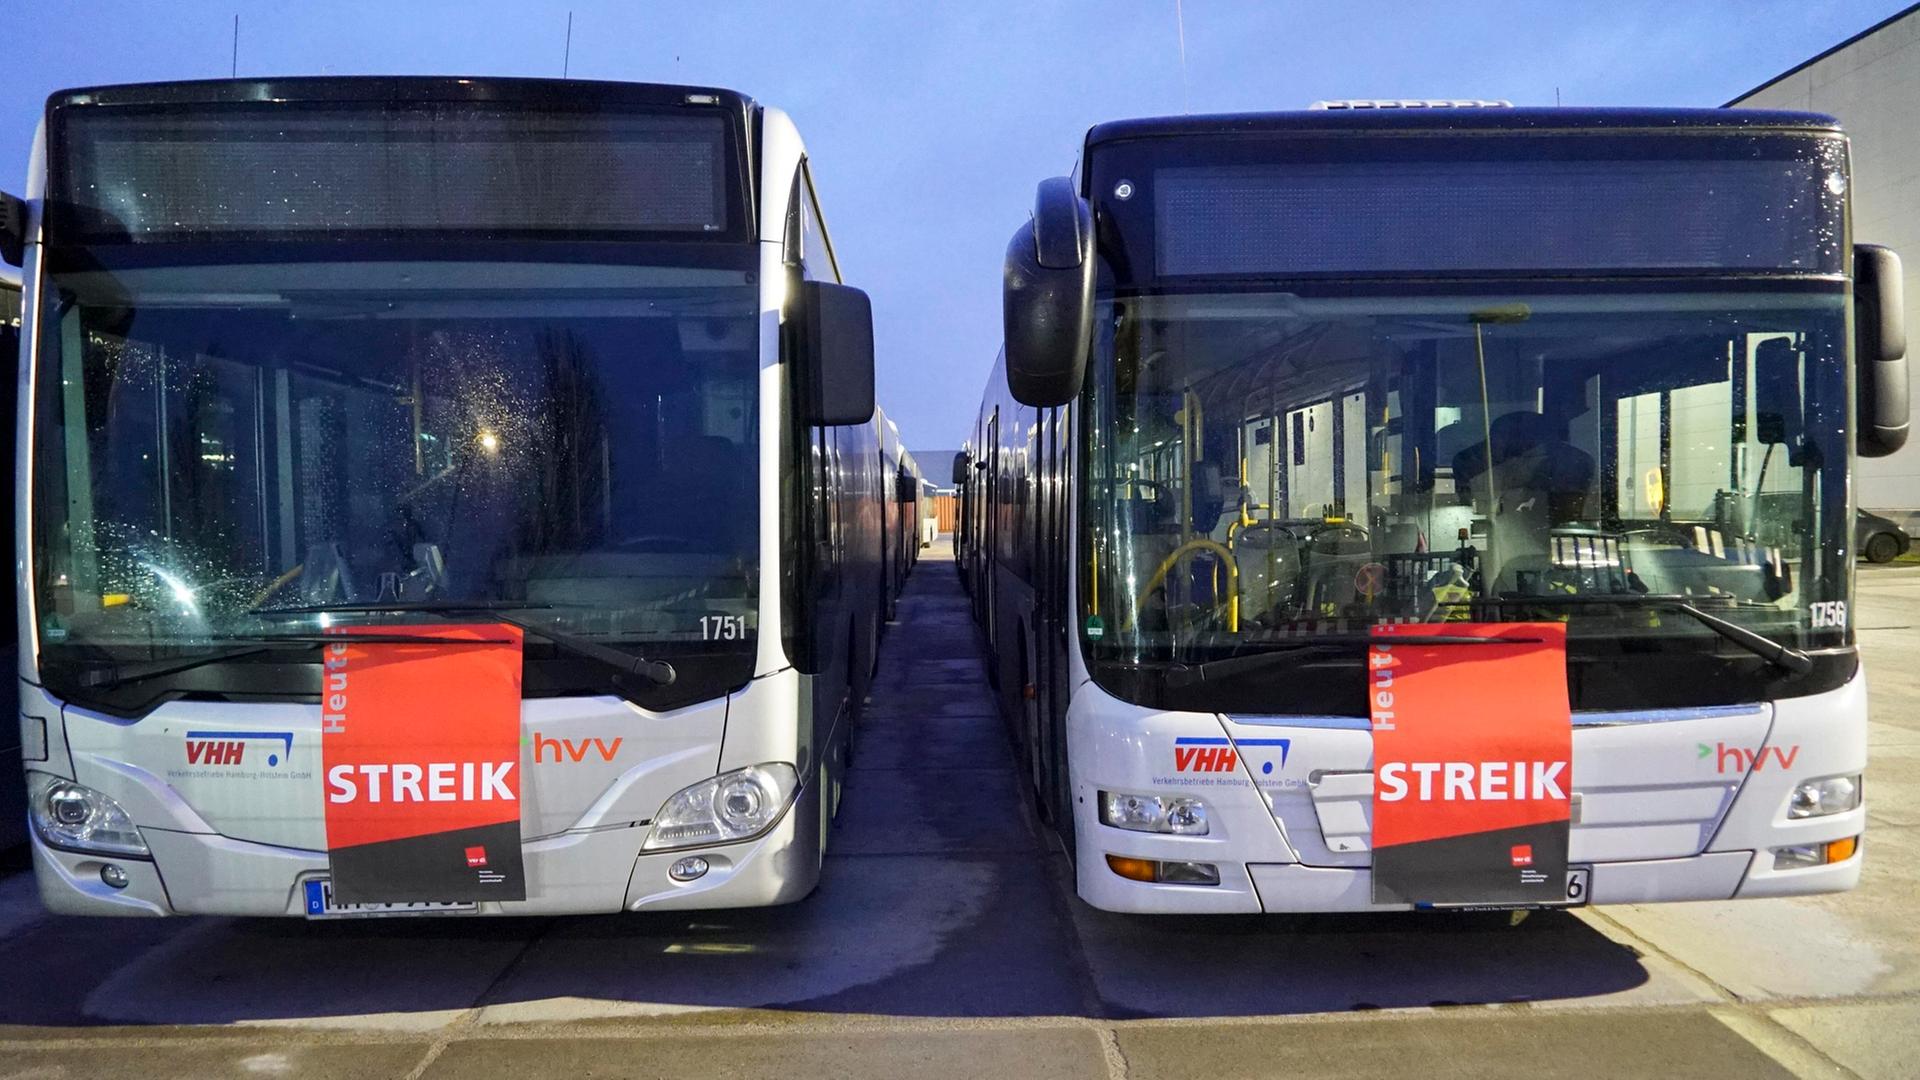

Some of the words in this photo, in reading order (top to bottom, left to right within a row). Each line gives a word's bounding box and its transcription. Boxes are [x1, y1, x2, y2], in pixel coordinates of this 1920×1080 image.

[1810, 600, 1846, 627] 1756
[700, 615, 745, 640] 1751
[185, 741, 245, 765] VHH
[533, 732, 623, 763] hvv
[1174, 748, 1238, 772] VHH
[1716, 742, 1799, 773] hvv
[290, 771, 312, 779] GmbH
[328, 761, 516, 803] STREIK
[1152, 776, 1214, 786] Verkehrsbetriebe
[1379, 761, 1567, 802] STREIK
[312, 900, 320, 909] D
